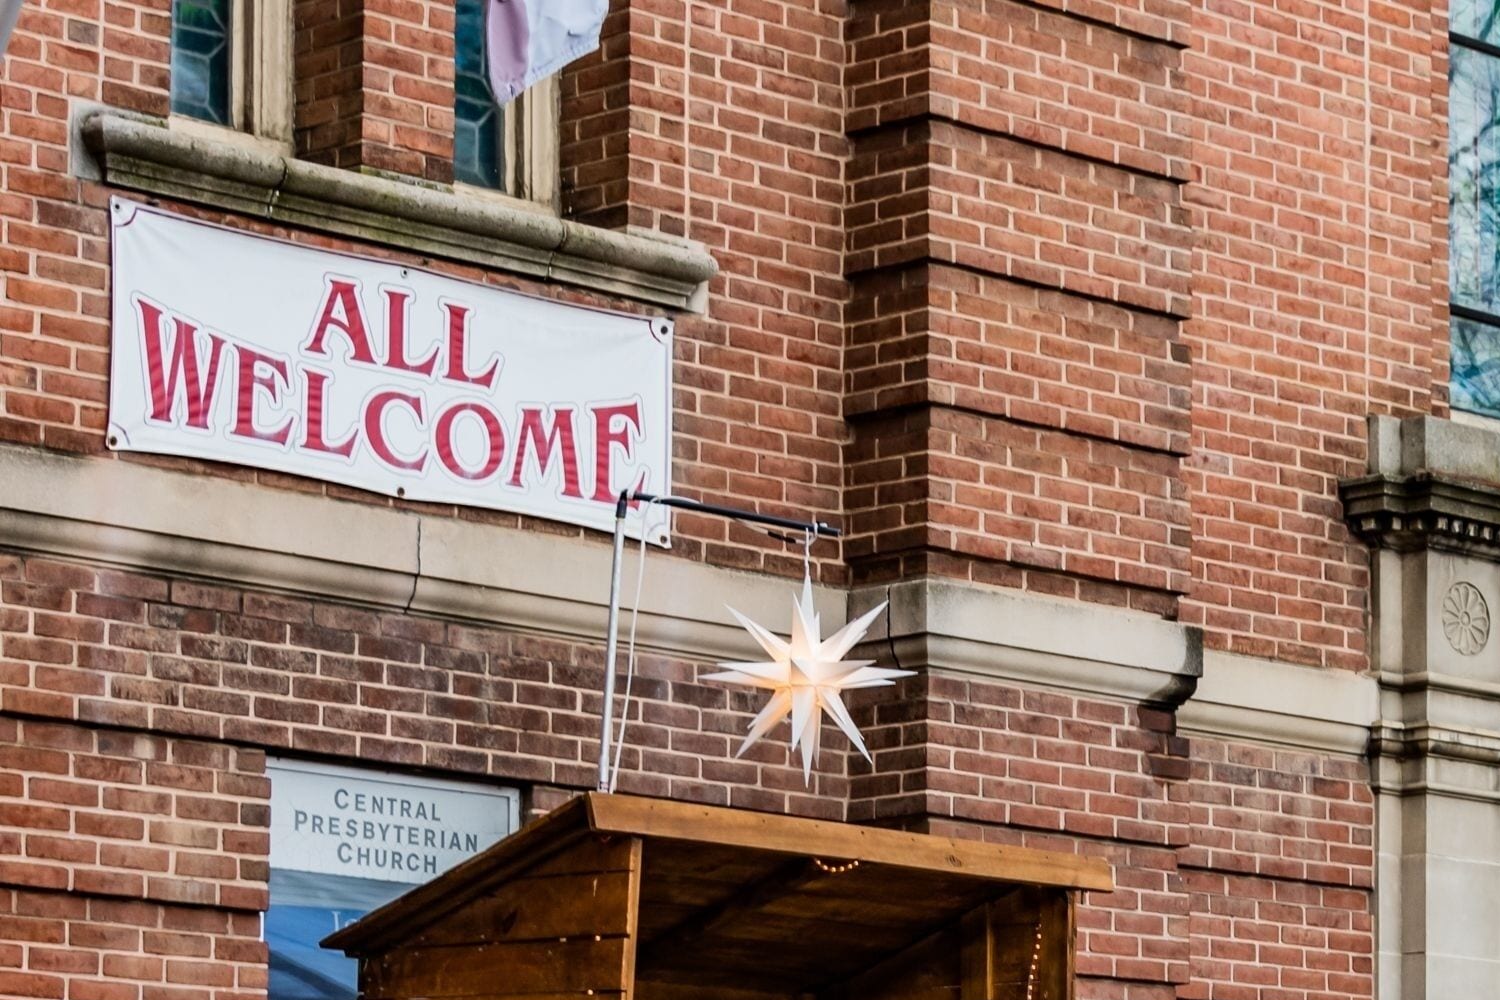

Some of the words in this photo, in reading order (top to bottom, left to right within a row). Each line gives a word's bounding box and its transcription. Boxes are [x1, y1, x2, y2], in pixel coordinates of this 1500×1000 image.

[305, 279, 500, 388] ALL
[136, 298, 646, 511] WELCOME
[334, 788, 441, 822] CENTRAL
[294, 810, 478, 853] PRESBYTERIAN
[337, 842, 437, 874] CHURCH
